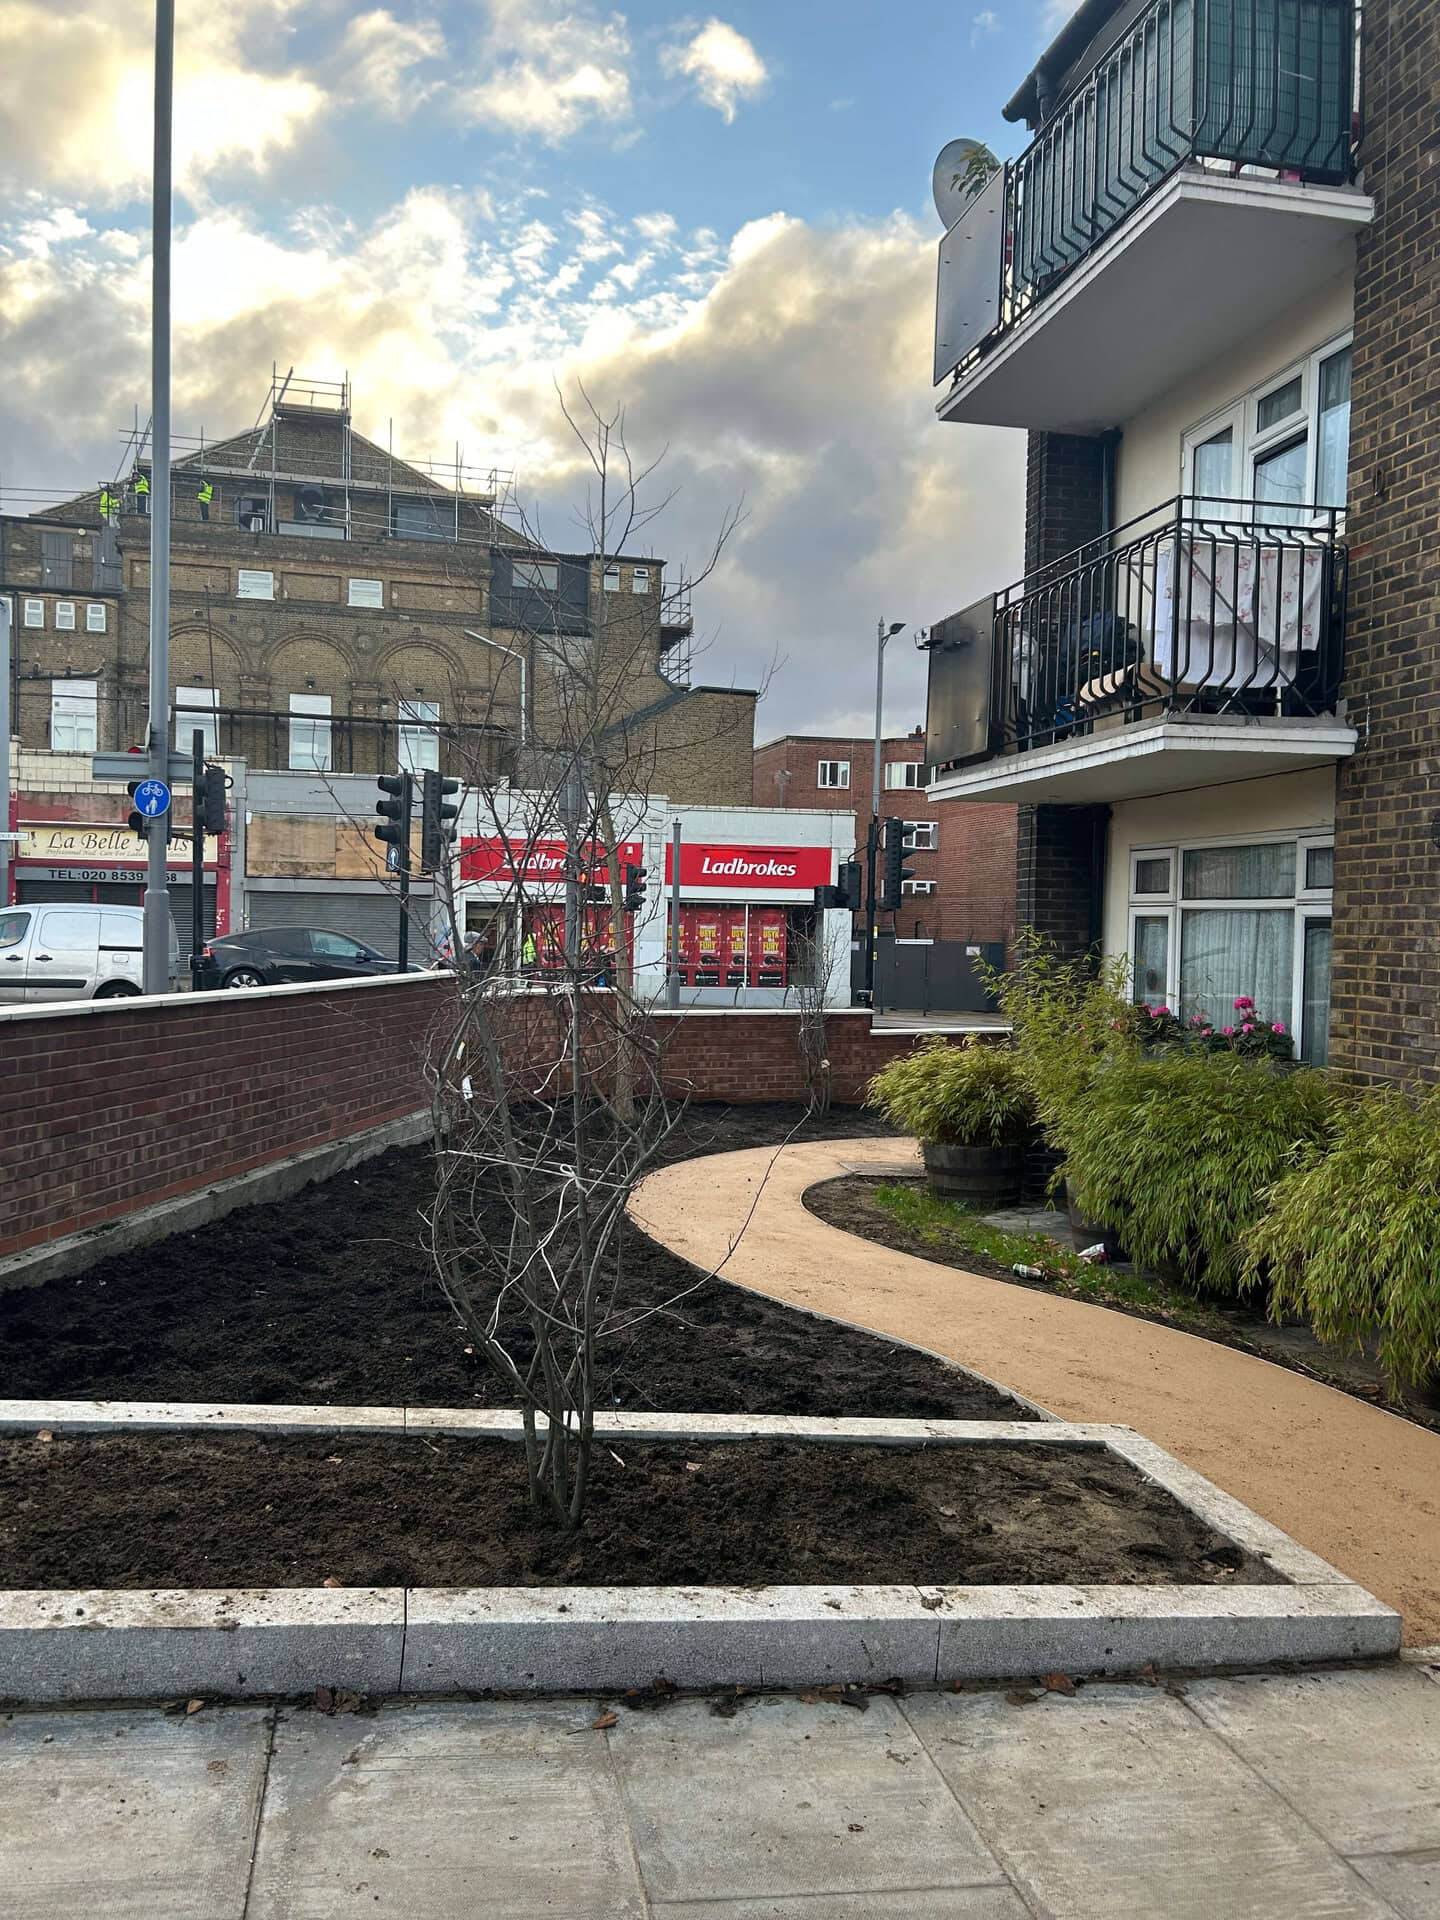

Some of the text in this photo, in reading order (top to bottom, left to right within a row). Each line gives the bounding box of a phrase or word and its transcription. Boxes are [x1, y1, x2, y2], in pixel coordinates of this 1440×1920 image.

[48, 831, 74, 849] La
[81, 830, 130, 850] Belle
[702, 857, 797, 876] Ladbrokes
[48, 869, 106, 880] TEL:020
[111, 871, 144, 882] 8539
[700, 941, 717, 951] FURY
[763, 942, 780, 951] FURY
